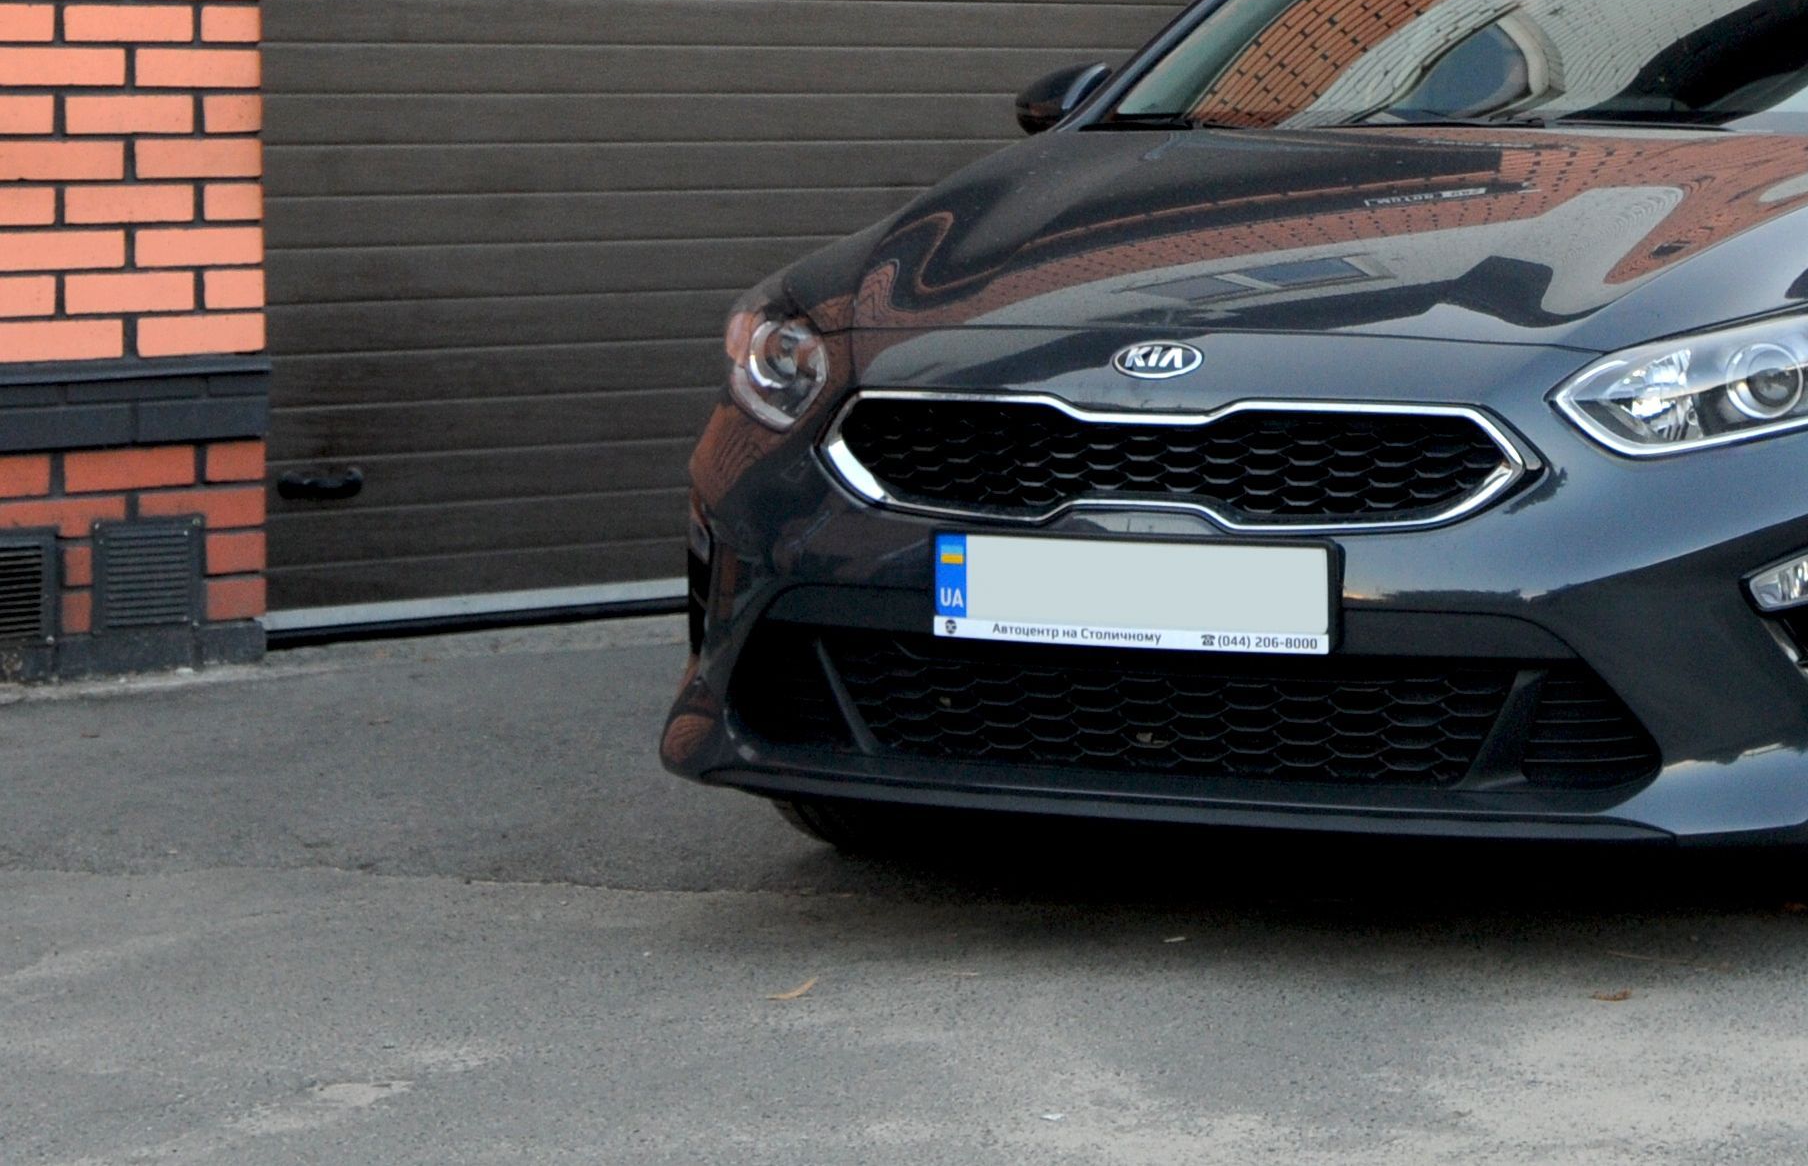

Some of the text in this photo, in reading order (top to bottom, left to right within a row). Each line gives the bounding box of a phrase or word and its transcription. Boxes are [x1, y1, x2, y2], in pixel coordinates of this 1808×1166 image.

[1124, 346, 1183, 368] KIA
[940, 587, 964, 608] UA
[992, 622, 1162, 645] Автоцентр на Столичному
[1217, 635, 1318, 650] (044) 206-8000
